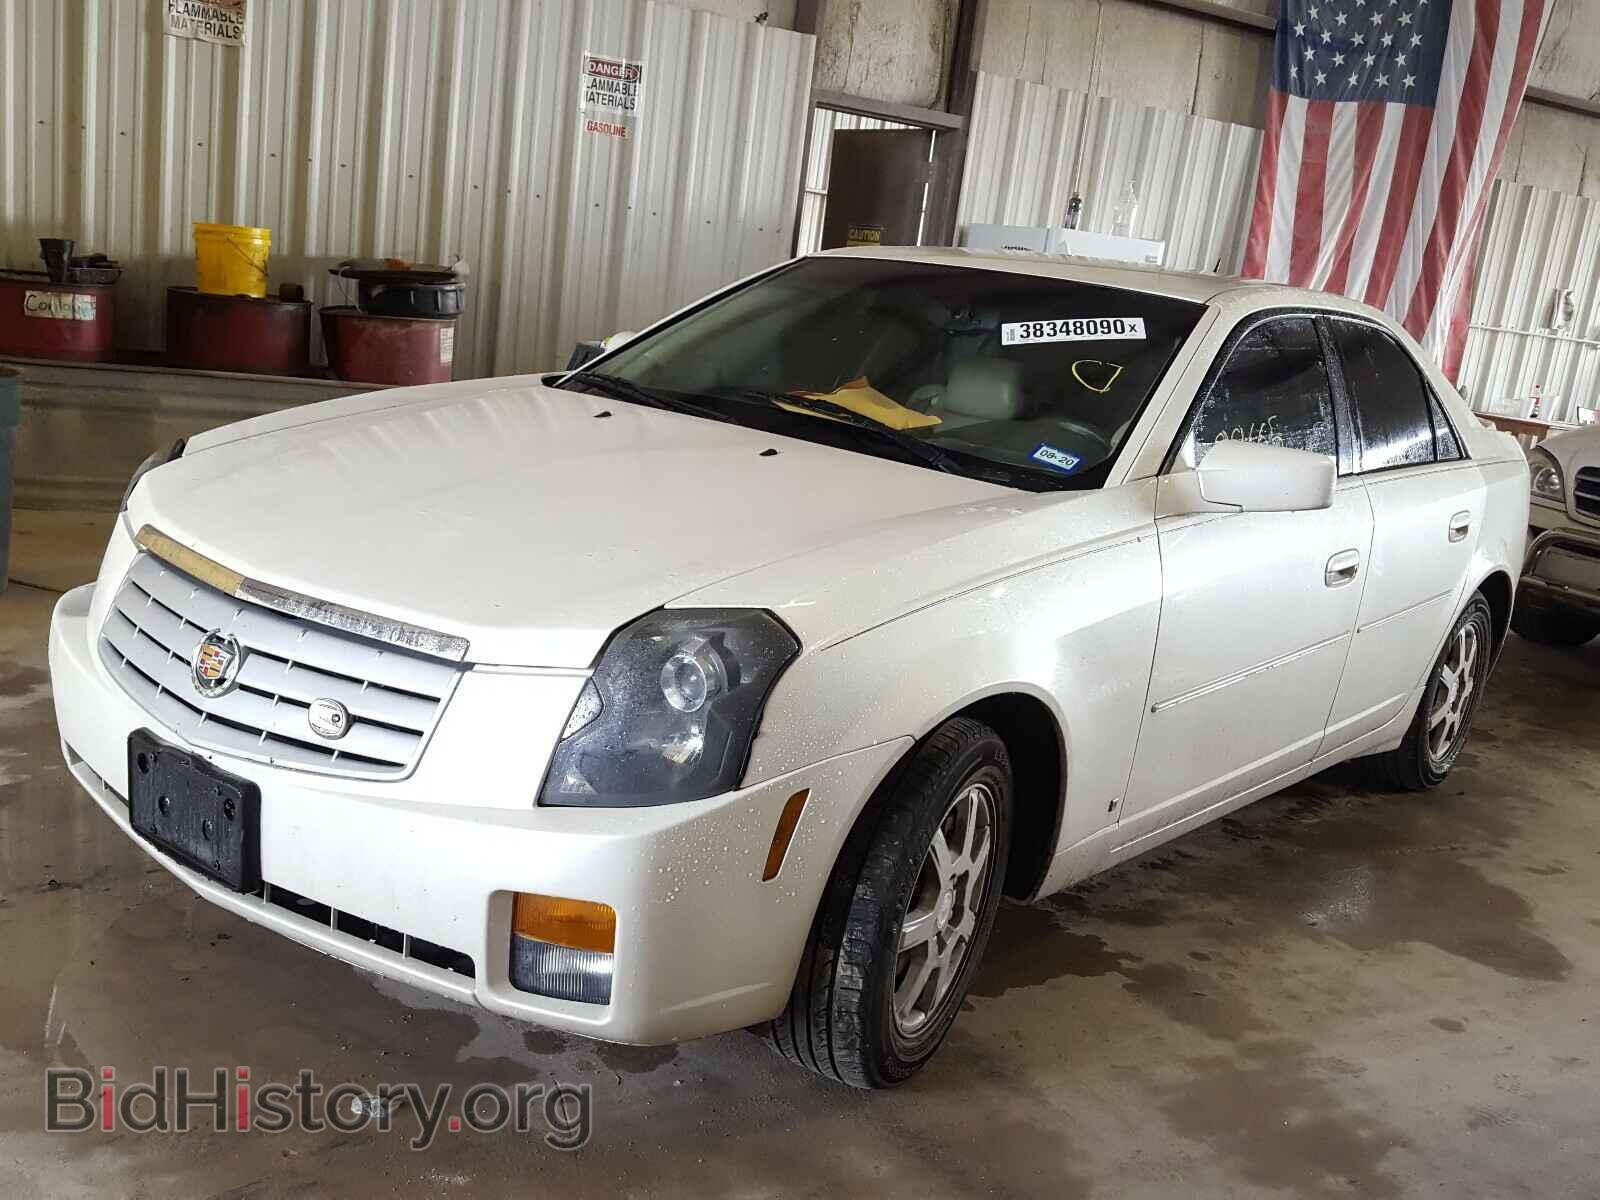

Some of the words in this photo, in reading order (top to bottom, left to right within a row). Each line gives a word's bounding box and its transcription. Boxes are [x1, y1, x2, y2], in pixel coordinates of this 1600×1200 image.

[170, 15, 241, 40] MATERIALS
[588, 61, 634, 79] DANGER
[586, 78, 637, 97] AMMABL
[586, 120, 626, 137] GASOLINE
[1019, 319, 1126, 339] 38348090
[1039, 449, 1075, 466] 08-20
